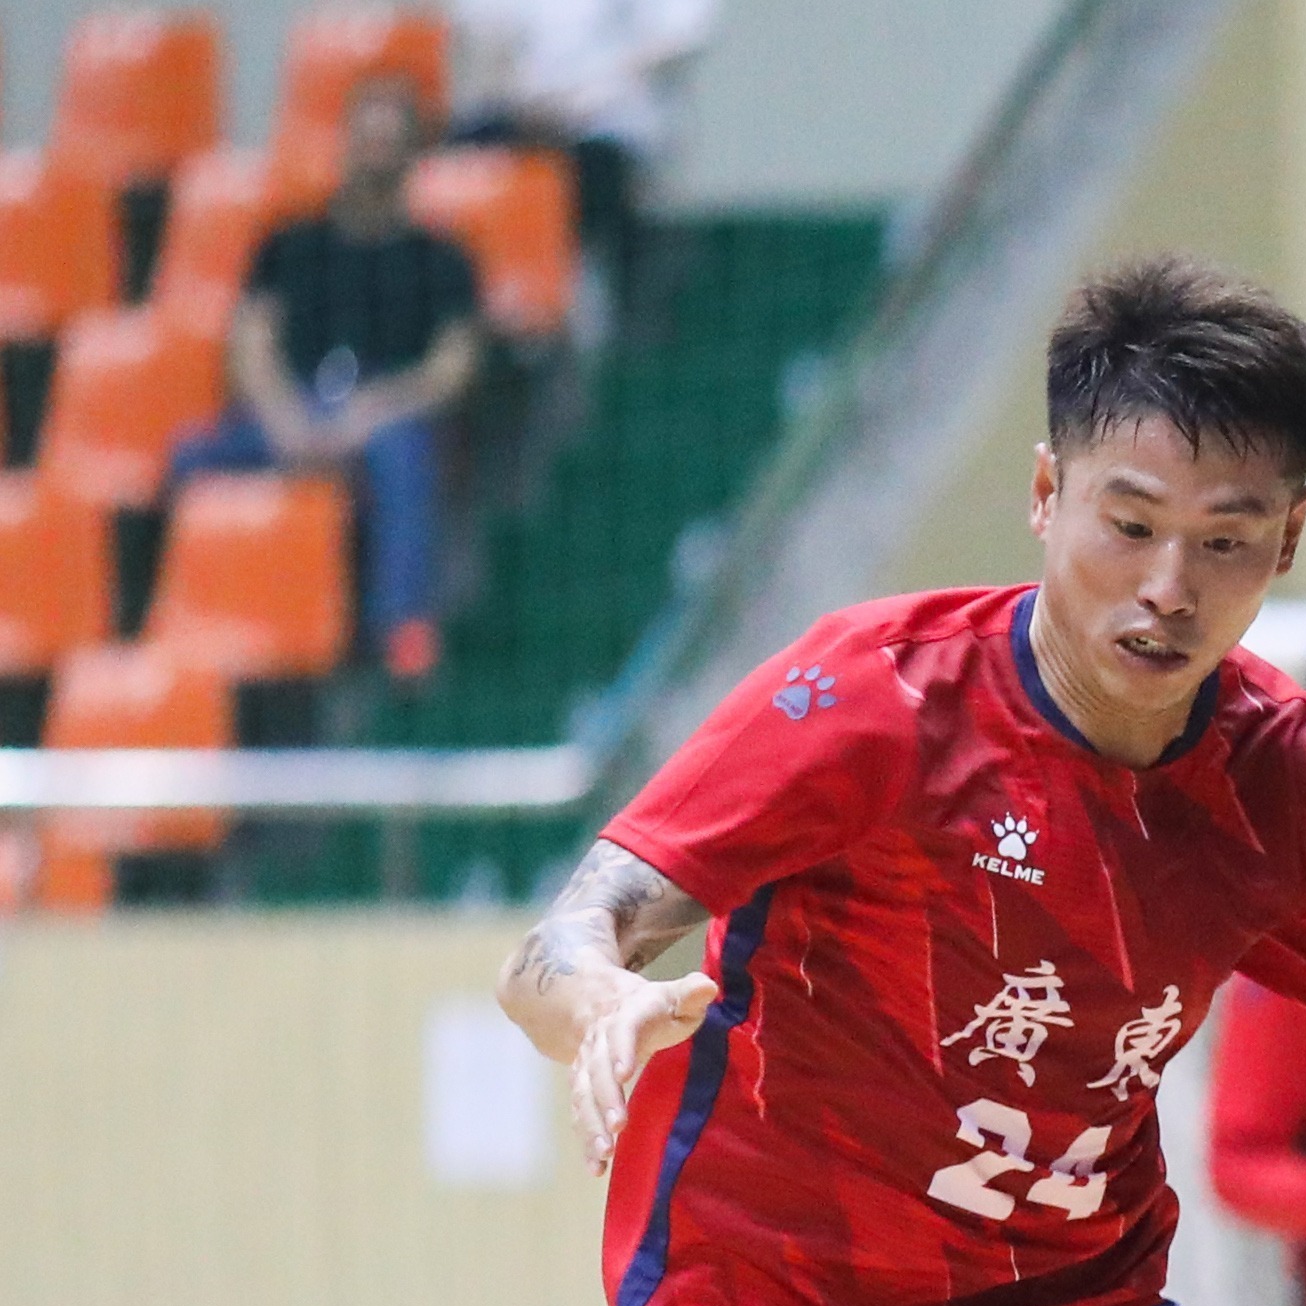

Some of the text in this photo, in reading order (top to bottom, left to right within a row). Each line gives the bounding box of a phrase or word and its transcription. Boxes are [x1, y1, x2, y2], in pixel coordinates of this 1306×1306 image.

[971, 852, 1045, 886] KELME
[940, 958, 1182, 1102] 廣東
[926, 1097, 1113, 1221] 24
